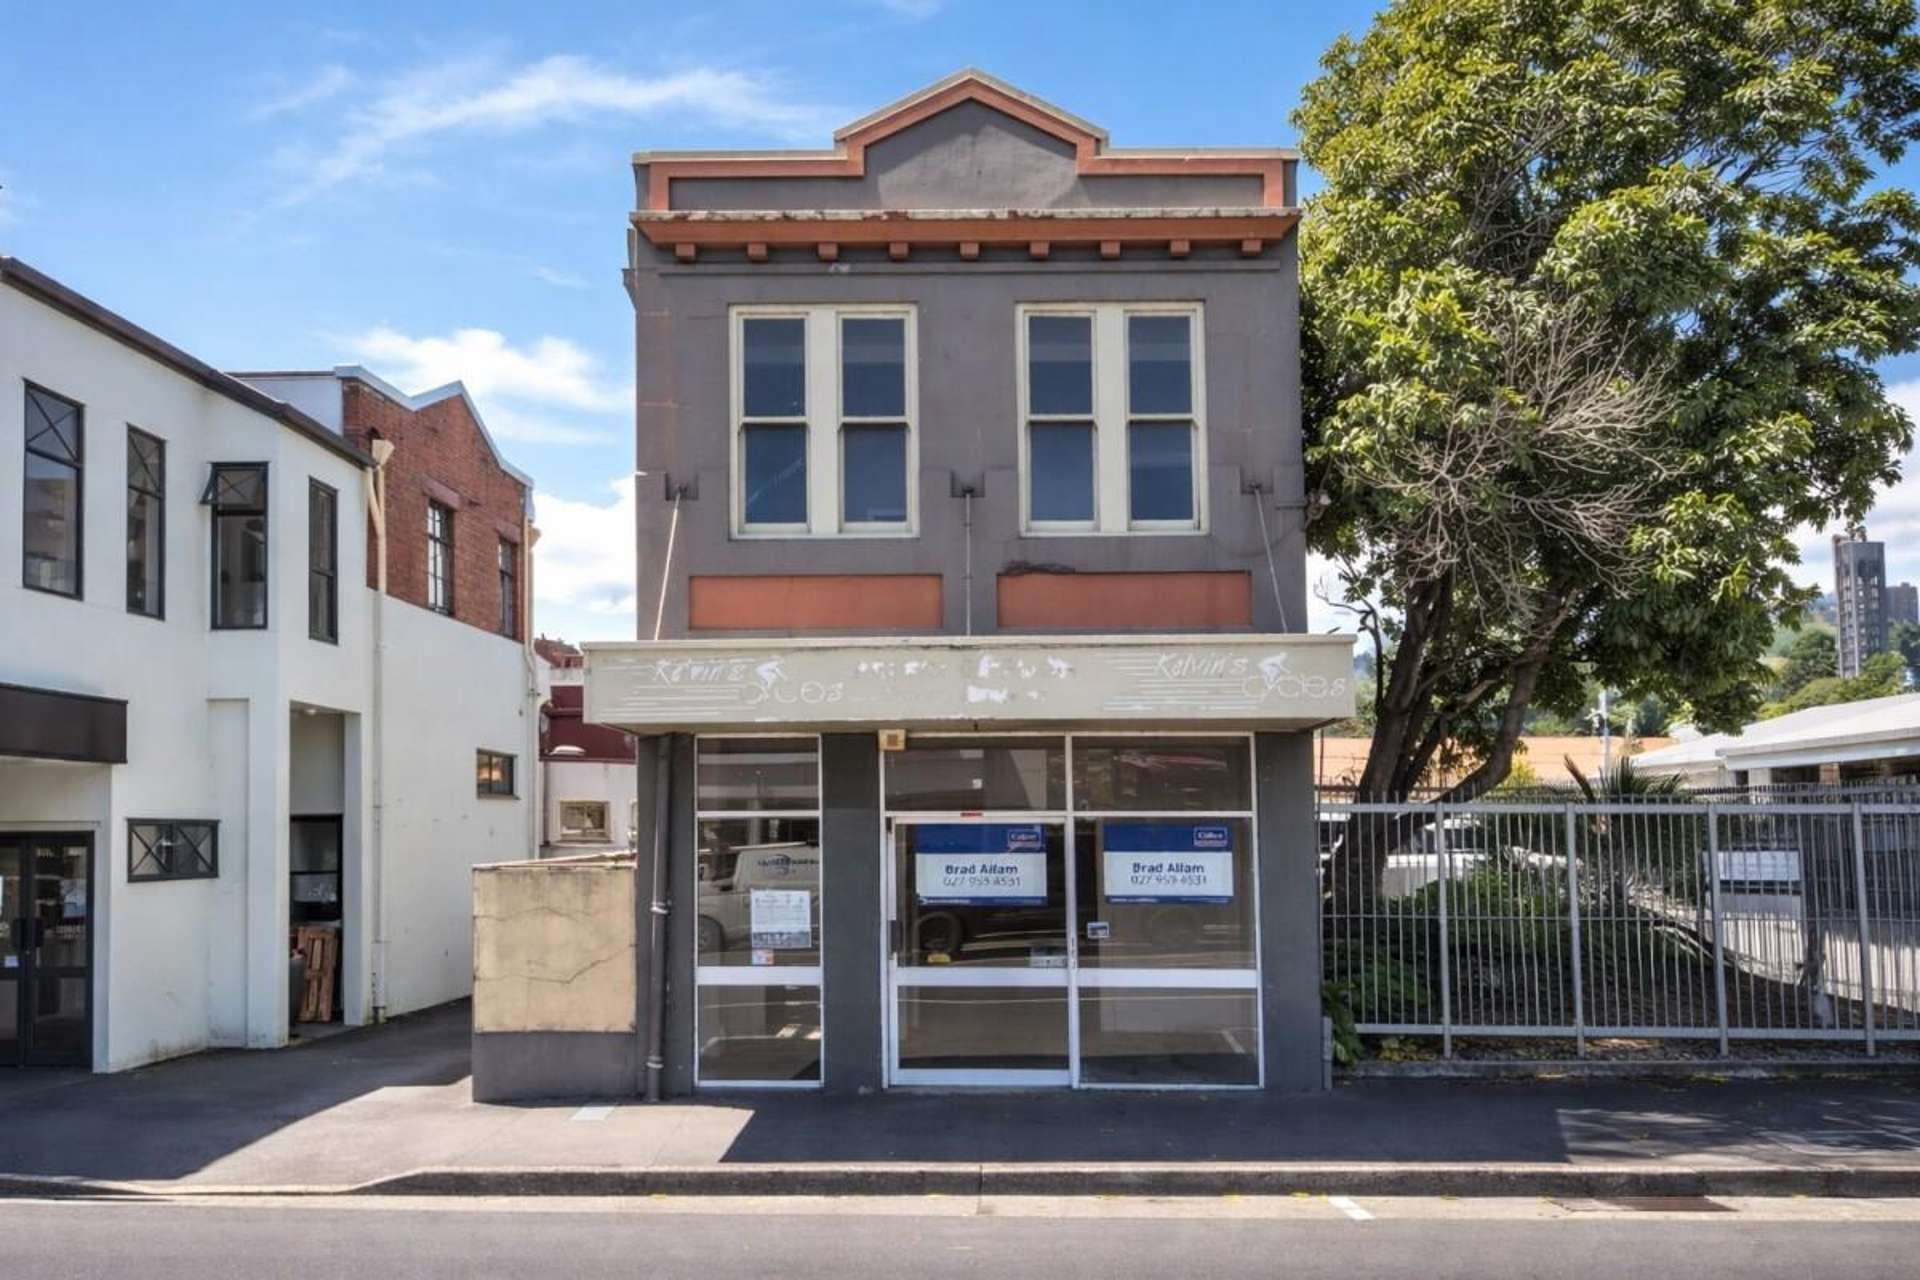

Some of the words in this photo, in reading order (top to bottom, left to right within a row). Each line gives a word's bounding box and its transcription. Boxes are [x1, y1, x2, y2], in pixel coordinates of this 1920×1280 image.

[945, 863, 976, 874] Brad
[1132, 862, 1164, 873] Brad
[1167, 862, 1205, 873] Allam
[943, 876, 966, 886] 027
[1130, 876, 1152, 885] 027
